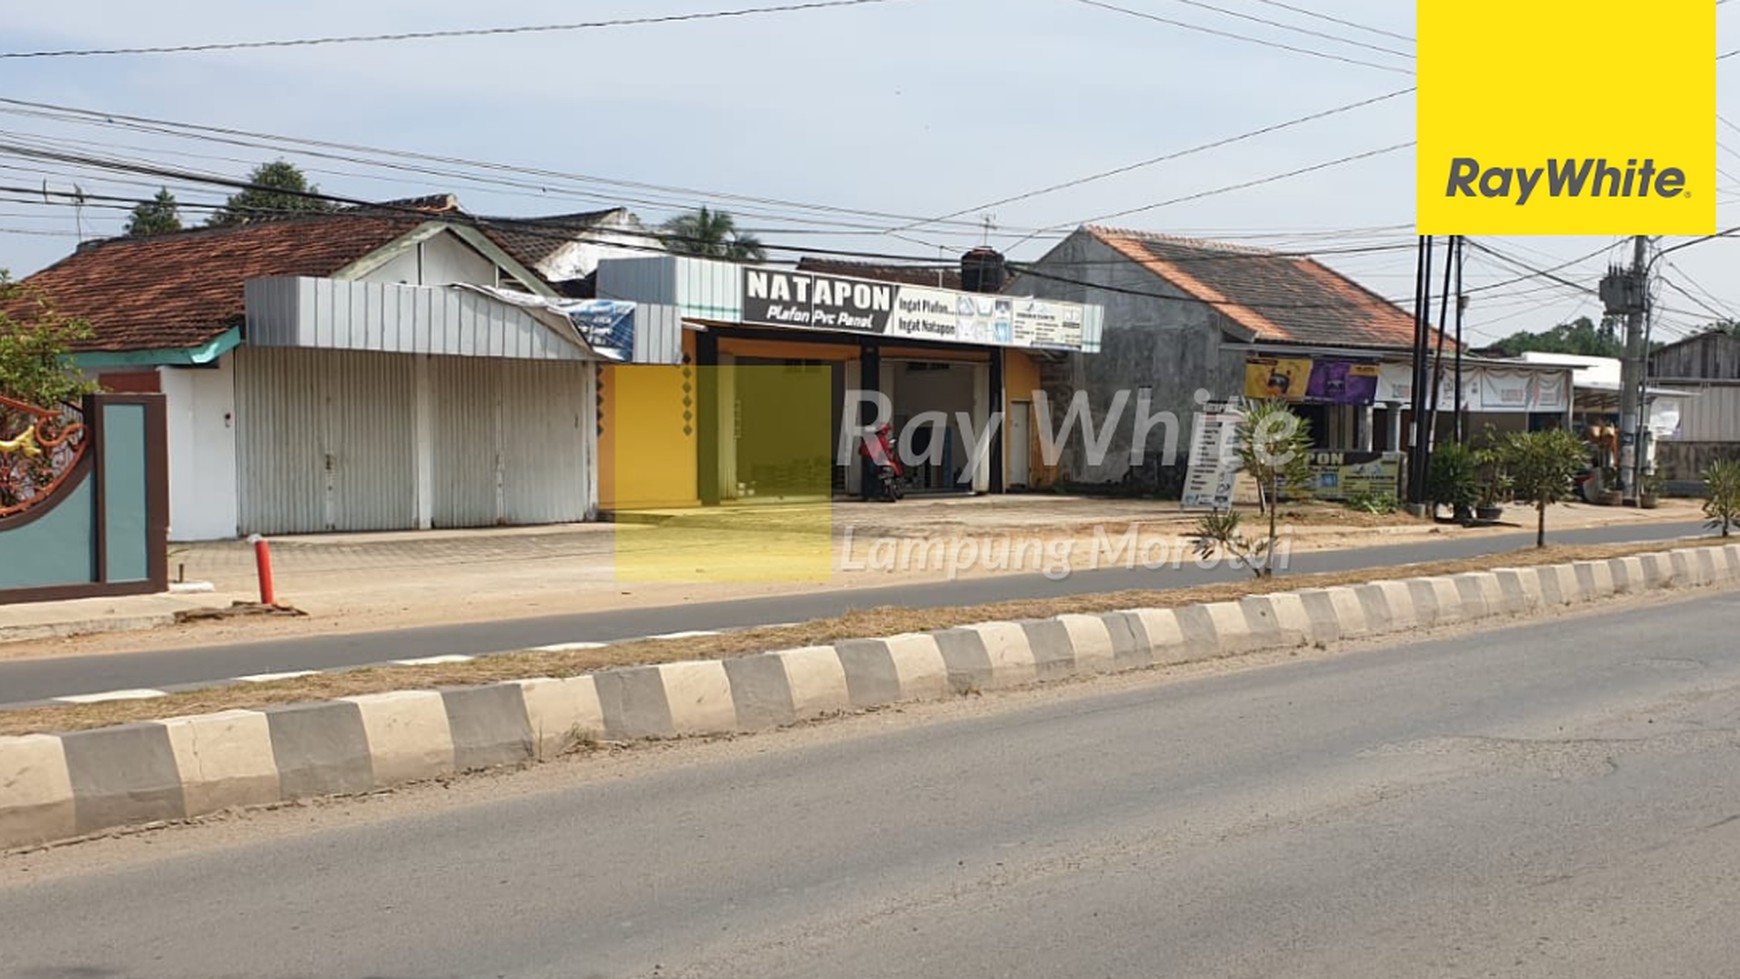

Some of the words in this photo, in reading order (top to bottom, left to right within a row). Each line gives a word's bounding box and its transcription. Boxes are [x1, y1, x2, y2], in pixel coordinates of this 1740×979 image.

[747, 270, 891, 311] NATAPON
[899, 296, 921, 313] Ingat
[766, 304, 810, 323] Plafon
[812, 309, 837, 325] Pvc
[837, 311, 874, 328] Panel
[899, 316, 921, 334] Ingat
[922, 318, 957, 337] Natapon
